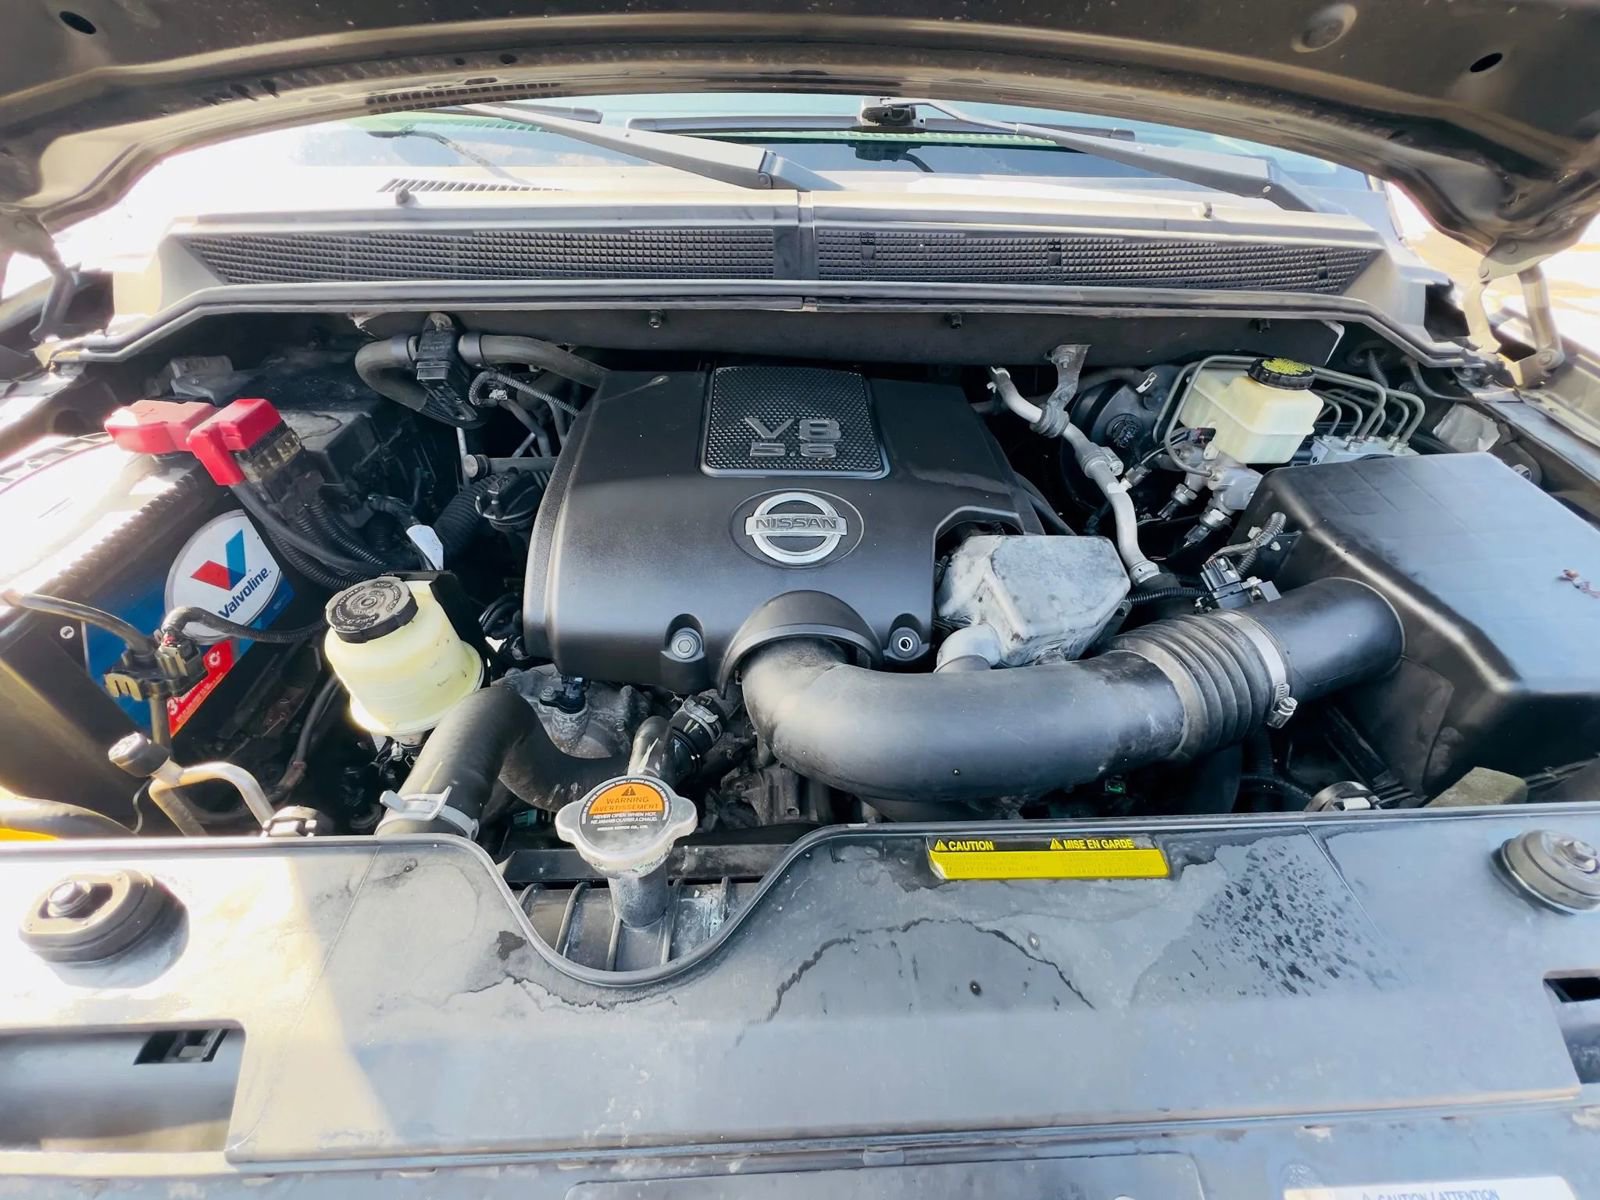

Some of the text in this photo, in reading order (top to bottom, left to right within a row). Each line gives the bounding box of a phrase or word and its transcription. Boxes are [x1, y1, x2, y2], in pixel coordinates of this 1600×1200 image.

[745, 417, 842, 441] V8
[750, 442, 836, 458] 5.6
[755, 516, 837, 529] NISSAN
[218, 567, 269, 619] Valvoline
[606, 796, 650, 804] WARNING
[948, 840, 994, 851] CAUTION
[1063, 838, 1135, 850] MISE EN GARDE
